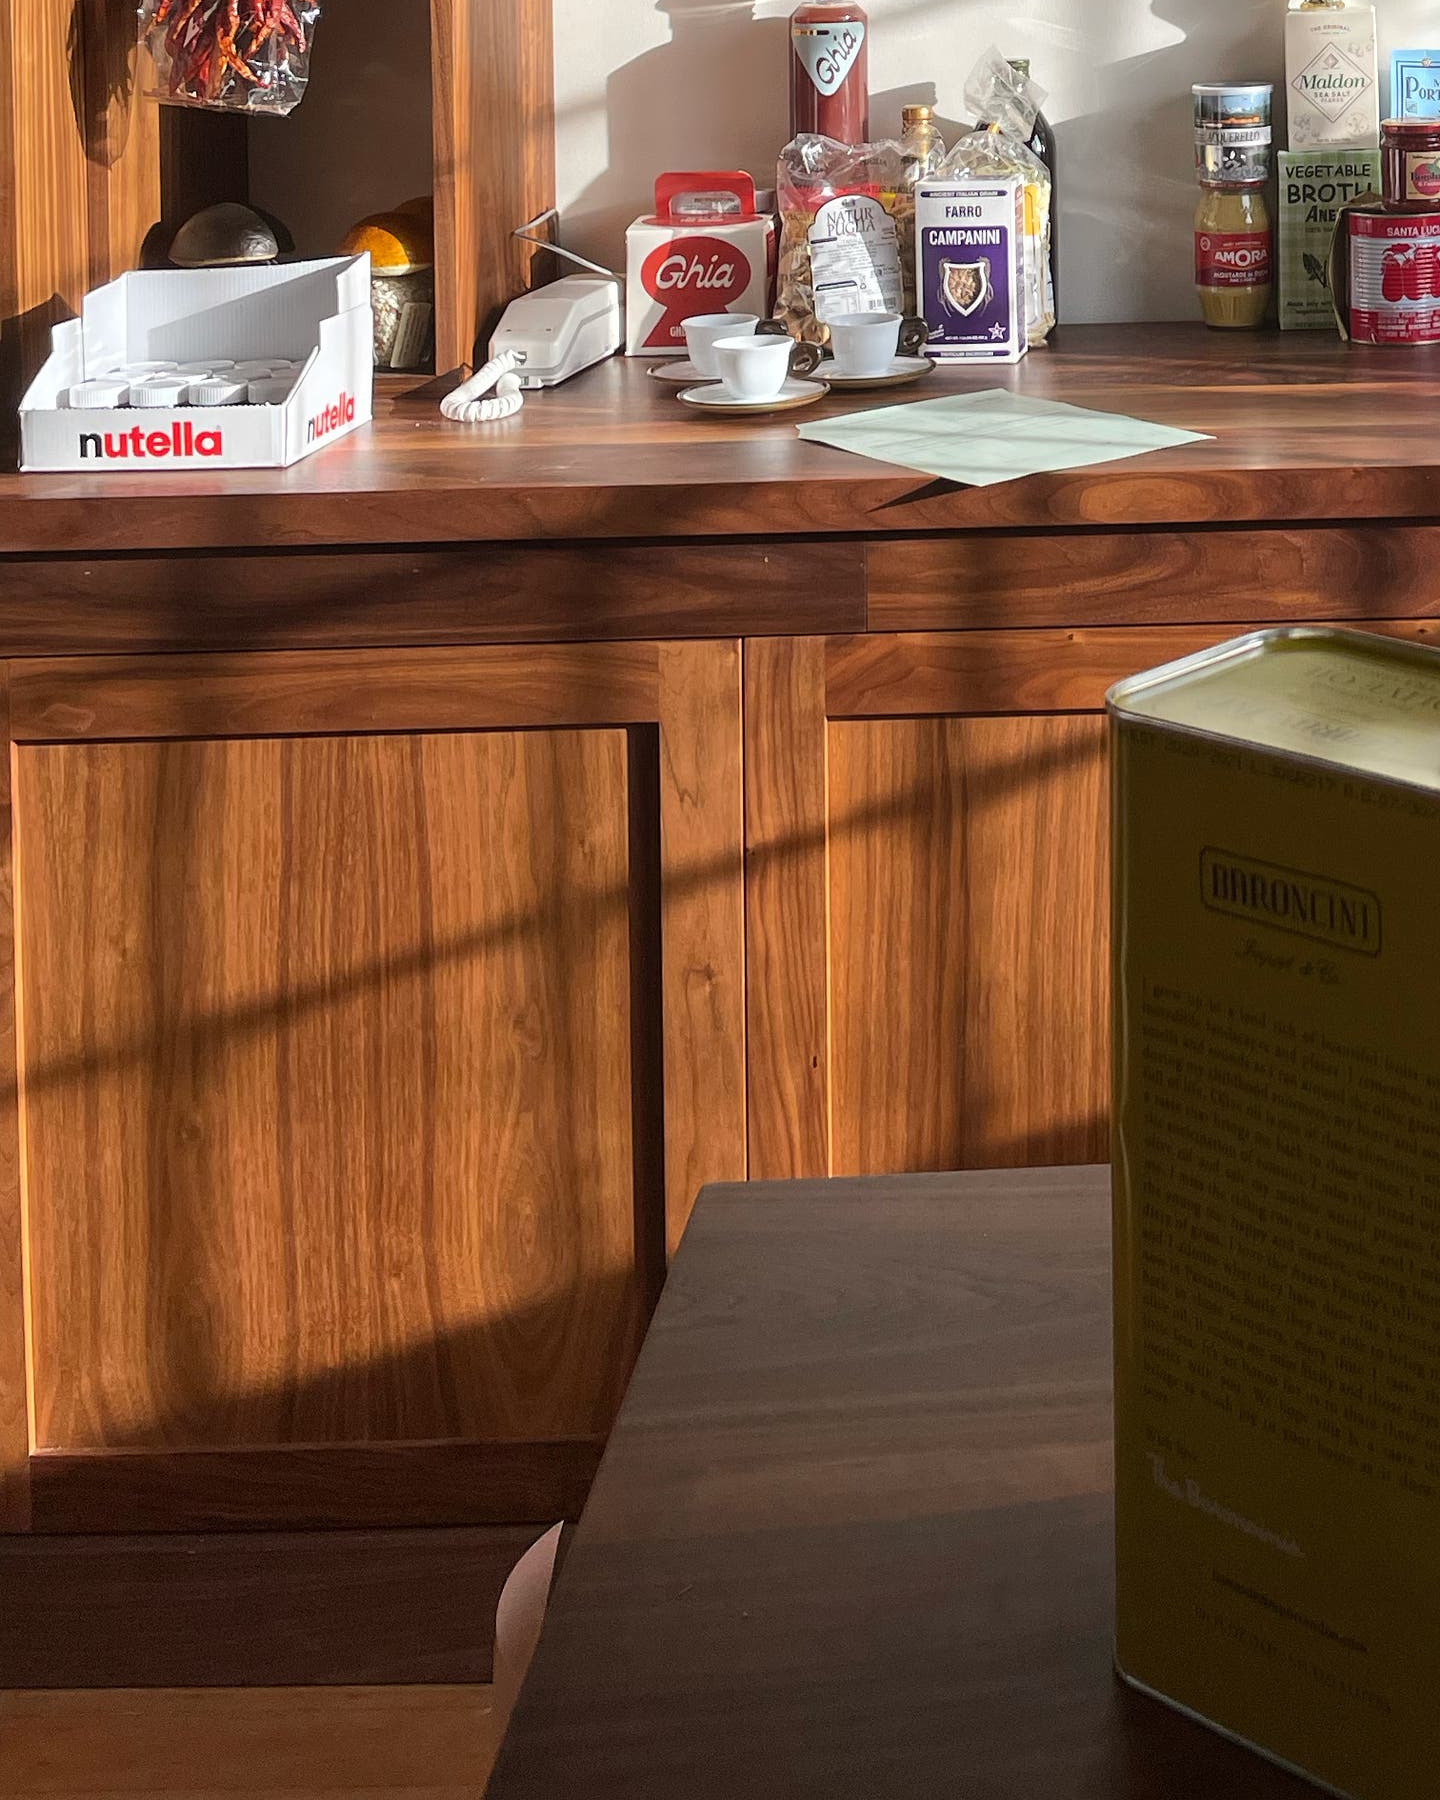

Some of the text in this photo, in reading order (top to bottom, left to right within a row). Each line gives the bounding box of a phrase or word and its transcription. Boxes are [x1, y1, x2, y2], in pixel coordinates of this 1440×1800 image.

[816, 28, 857, 84] Ghia
[1299, 73, 1366, 90] Maldon
[1285, 164, 1371, 179] VEGETABLE
[1287, 182, 1372, 204] BROTH
[826, 207, 875, 224] NATUR
[945, 205, 983, 218] FARRO
[827, 220, 876, 237] PUGLIA
[1387, 227, 1419, 238] SANTA
[929, 229, 1001, 246] CAMPANINI
[1214, 249, 1267, 267] AMORA
[656, 255, 735, 290] Ghia
[307, 390, 355, 443] nutella
[79, 420, 223, 458] nutella
[1212, 863, 1369, 940] BARONCINI
